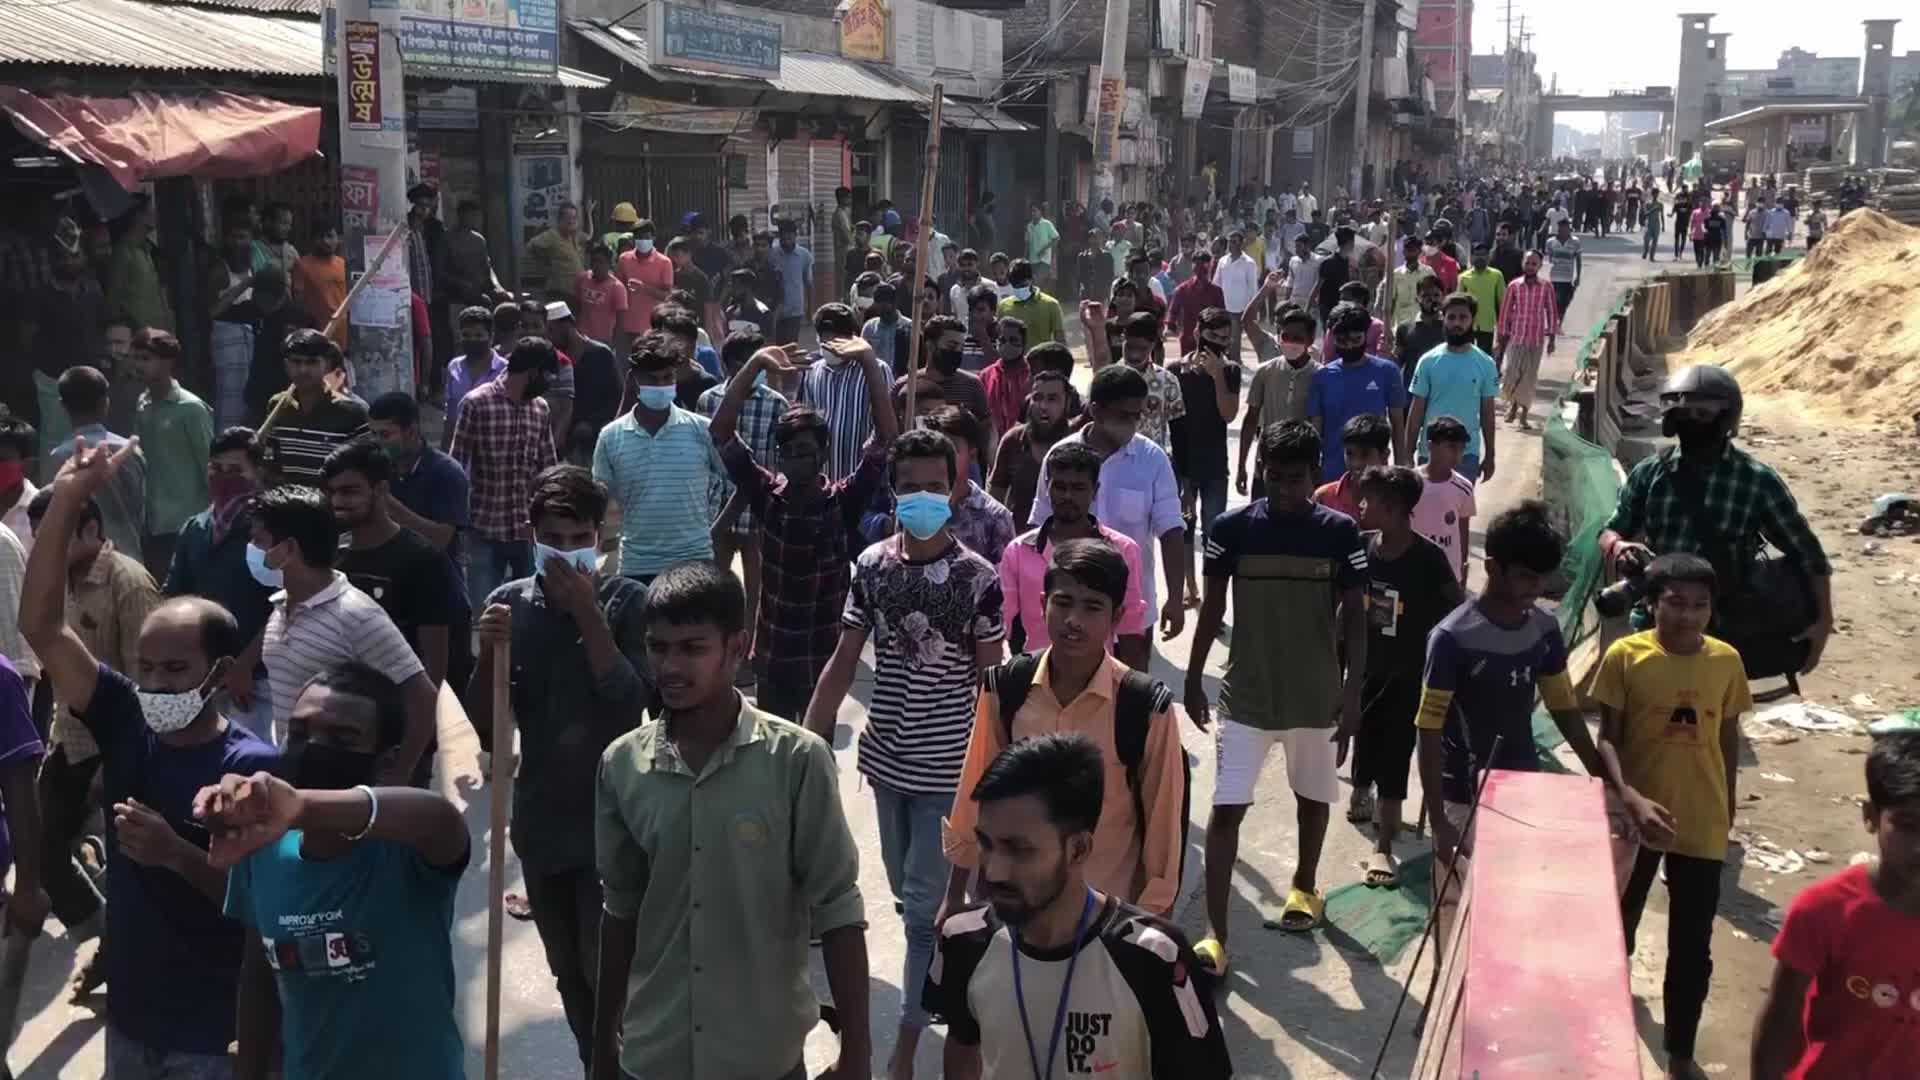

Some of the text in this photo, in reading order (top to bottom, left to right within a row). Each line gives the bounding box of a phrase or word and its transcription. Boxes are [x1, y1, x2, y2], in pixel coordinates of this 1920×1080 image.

[1066, 1012, 1112, 1036] JUST
[1066, 1033, 1095, 1055] DO
[1067, 1054, 1092, 1073] IT.
